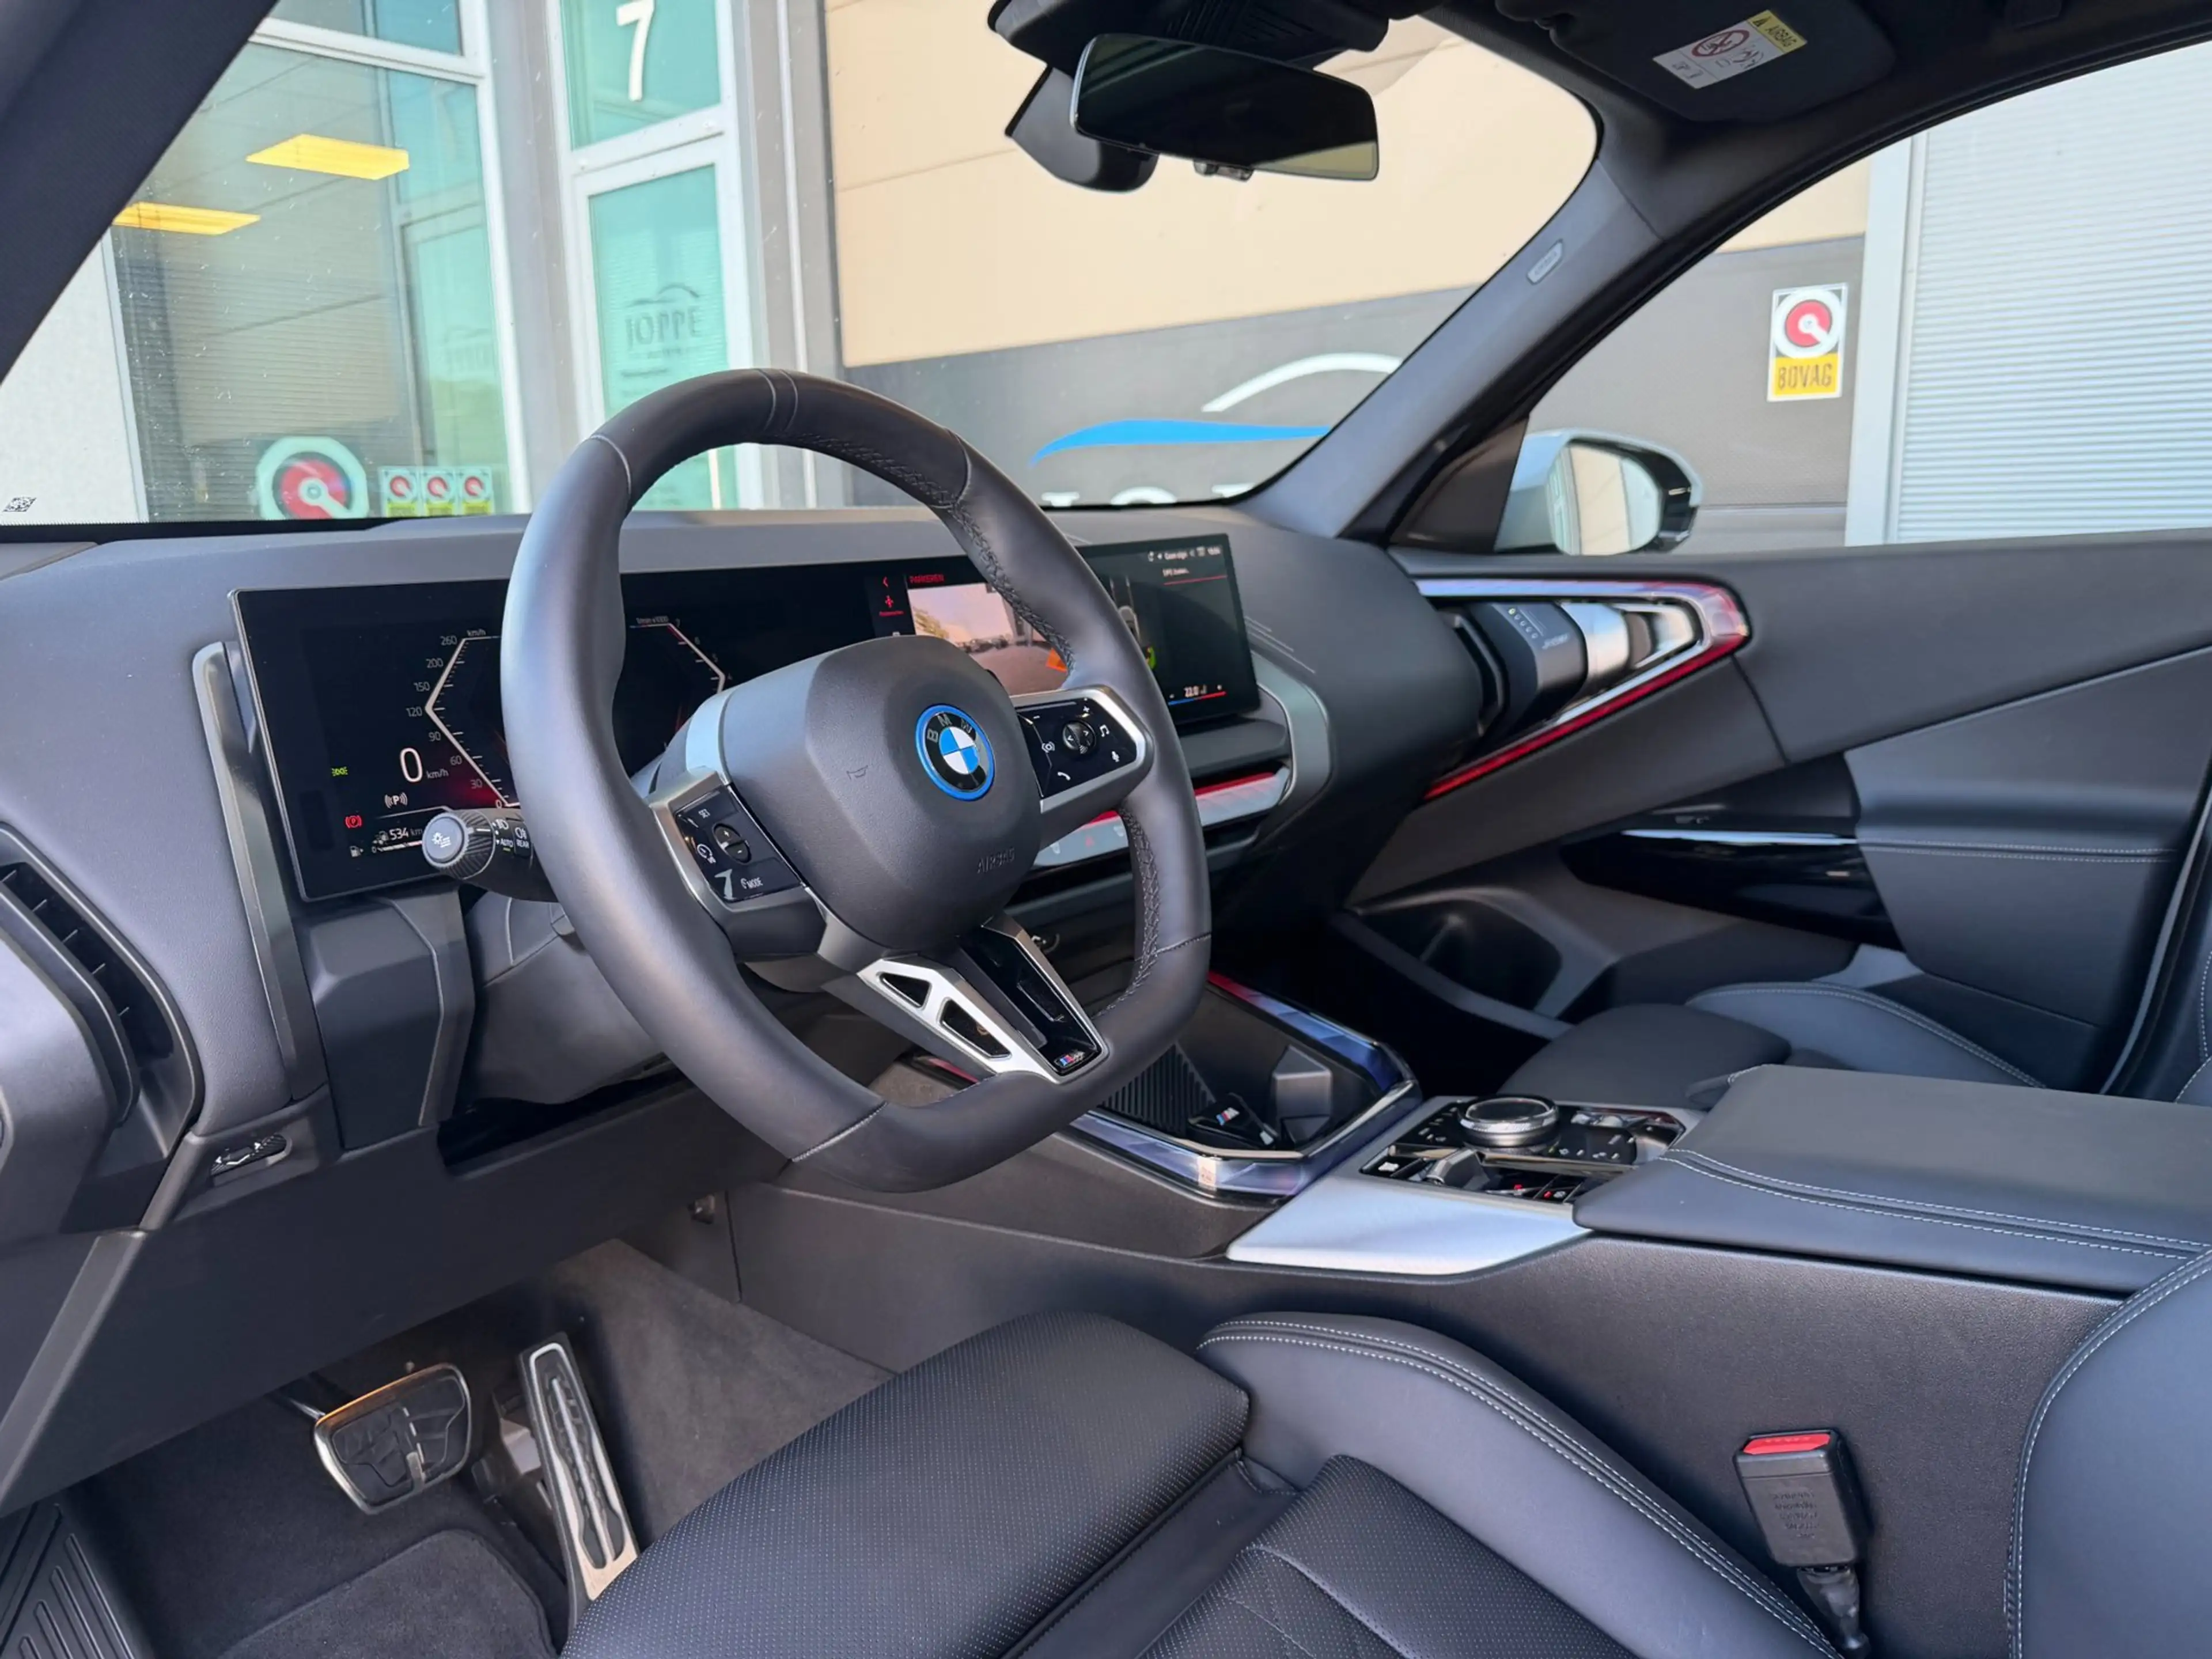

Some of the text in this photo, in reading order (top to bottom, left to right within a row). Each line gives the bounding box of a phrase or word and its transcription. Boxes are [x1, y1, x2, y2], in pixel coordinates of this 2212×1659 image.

[1766, 24, 1798, 48] AIRBAG
[616, 0, 655, 102] 7
[624, 306, 702, 351] JOPPE
[1778, 362, 1833, 391] BOVAG
[466, 628, 486, 637] km/h
[440, 635, 457, 646] 260
[426, 658, 444, 668] 200
[414, 681, 431, 692] 150
[406, 707, 423, 717] 120
[926, 713, 974, 744] BMW
[429, 732, 441, 742] 90
[399, 747, 449, 783] 0 km/h
[450, 755, 463, 766] 60
[470, 779, 483, 789] 30
[495, 799, 502, 809] 0
[389, 827, 410, 840] 534
[500, 838, 514, 848] AUTO
[516, 839, 530, 849] REAR
[976, 846, 1016, 874] AIRBAG
[747, 877, 764, 889] MODE
